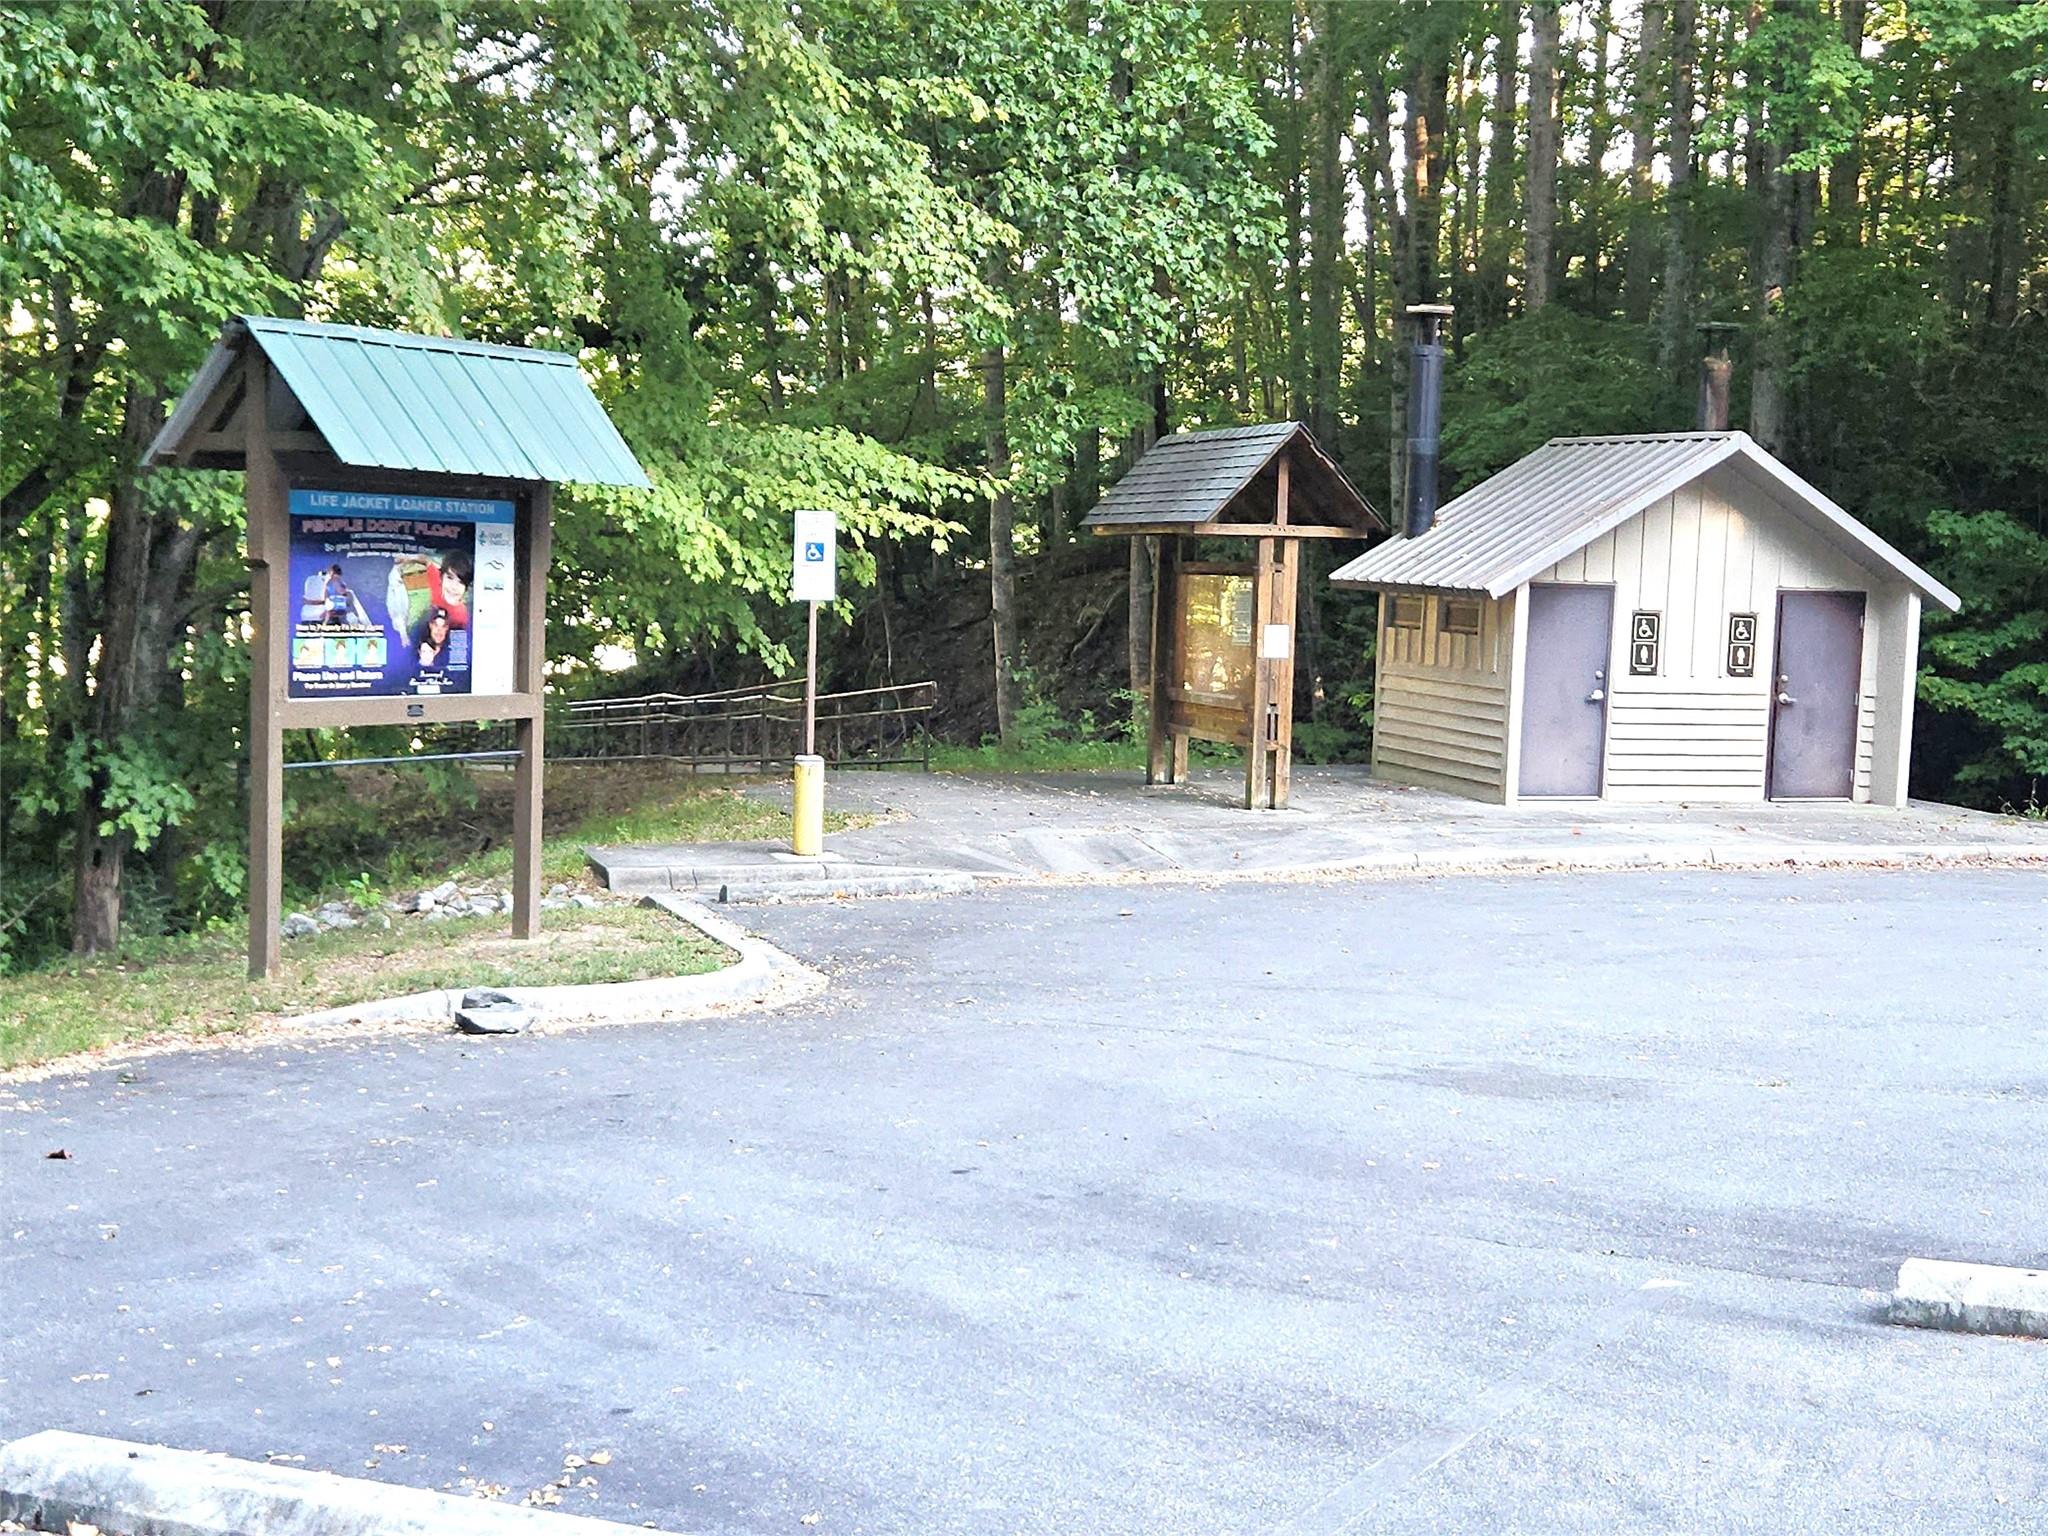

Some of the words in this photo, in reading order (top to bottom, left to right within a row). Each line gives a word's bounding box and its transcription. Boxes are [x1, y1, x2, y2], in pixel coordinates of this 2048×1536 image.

[310, 493, 338, 507] LIFE
[342, 495, 392, 509] JACKET
[394, 498, 442, 511] LOANER
[445, 501, 495, 514] STATION
[302, 519, 364, 533] PEOPLE
[414, 521, 461, 539] FLOAT
[324, 543, 335, 552] So
[293, 671, 321, 682] Please
[340, 671, 356, 681] and
